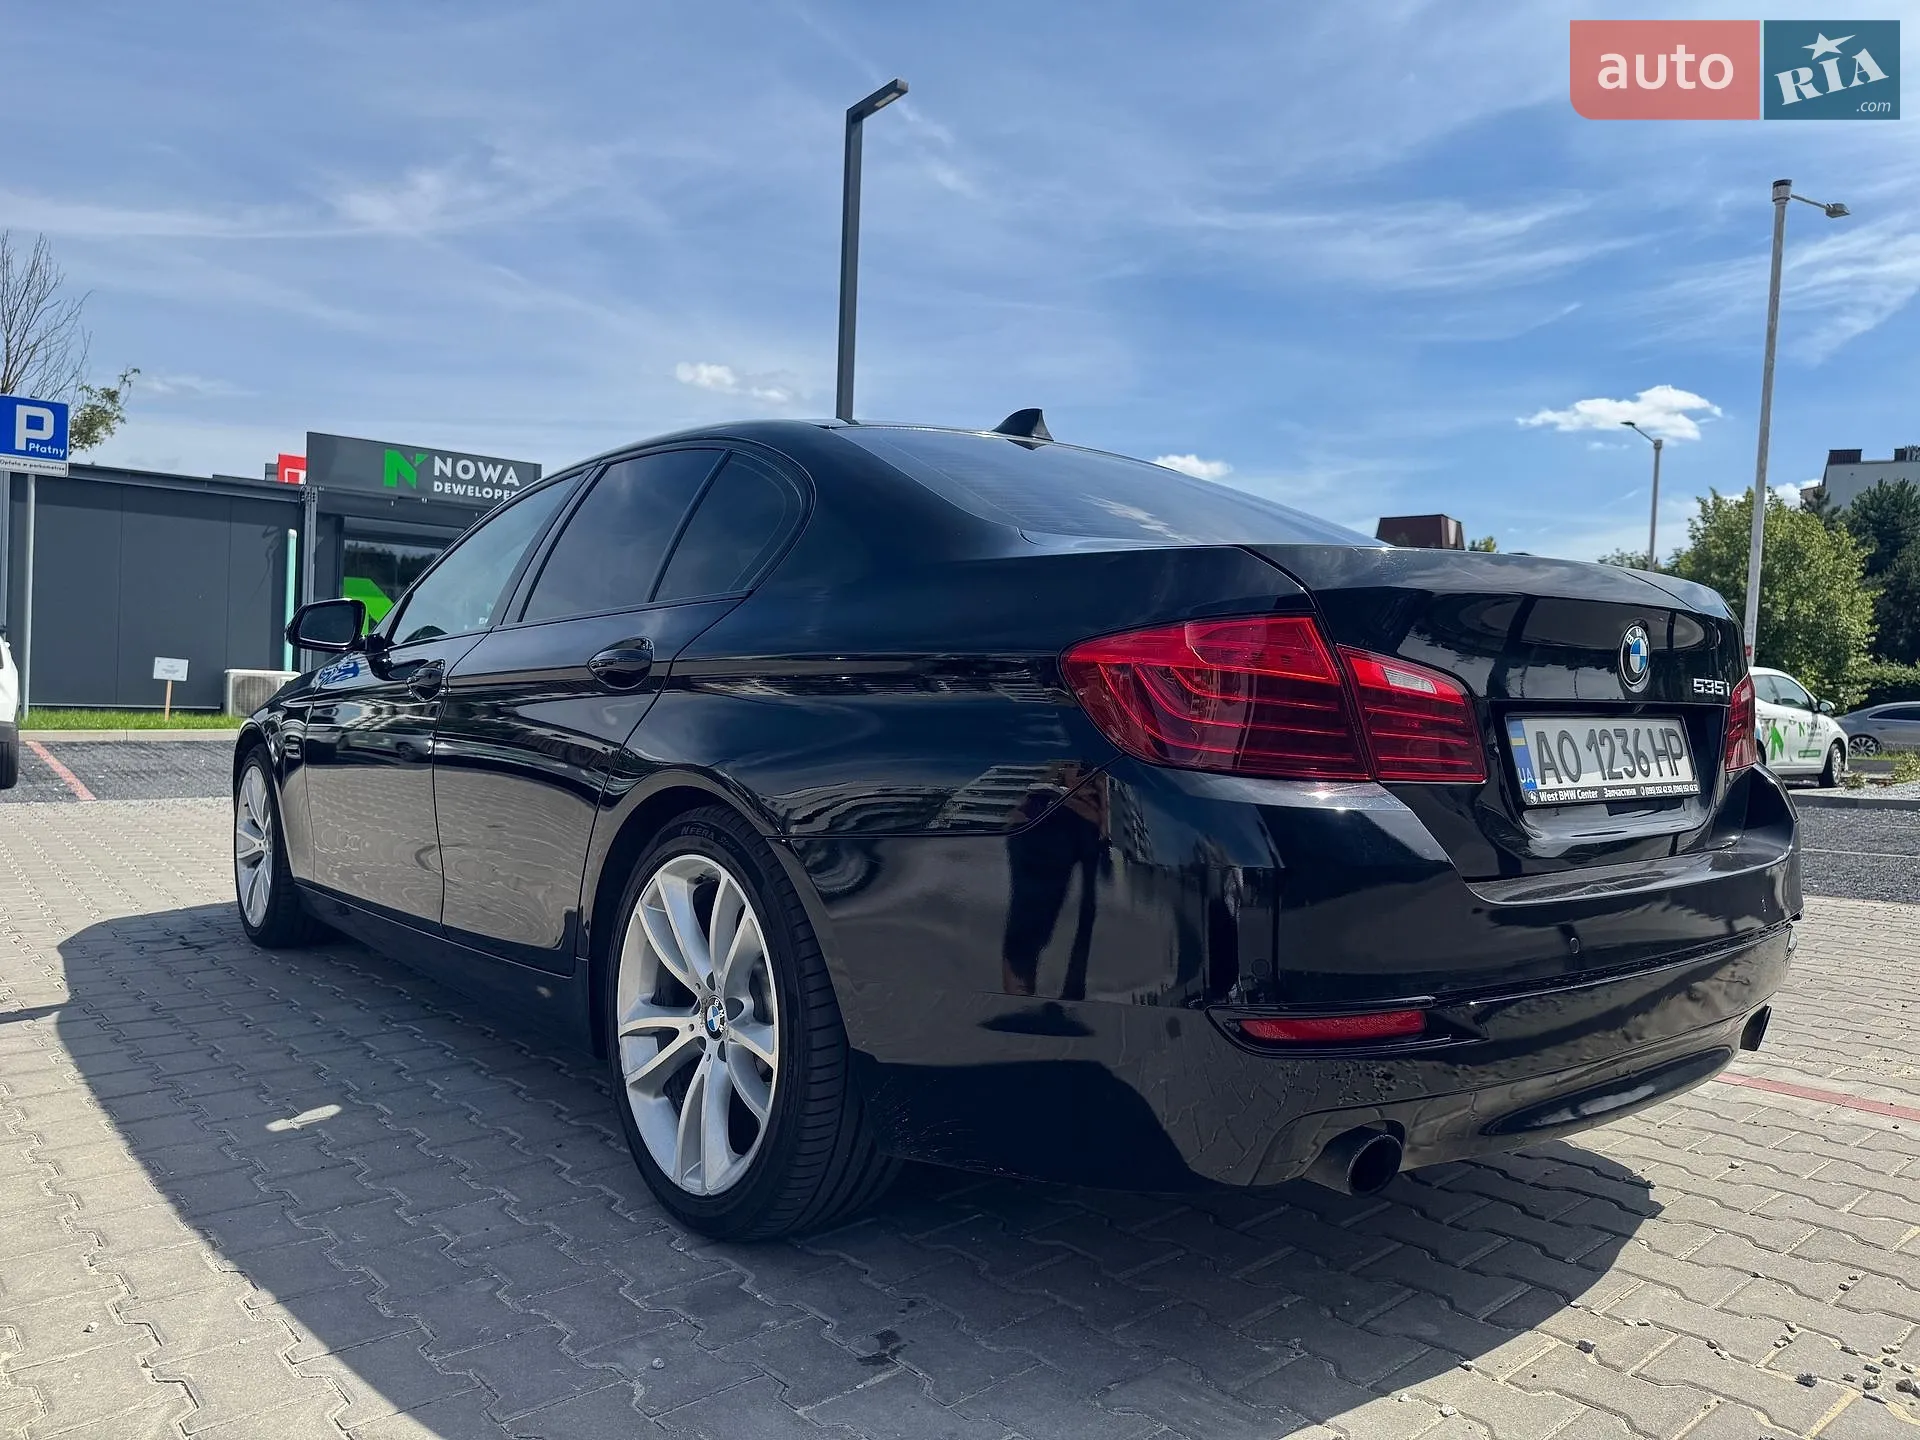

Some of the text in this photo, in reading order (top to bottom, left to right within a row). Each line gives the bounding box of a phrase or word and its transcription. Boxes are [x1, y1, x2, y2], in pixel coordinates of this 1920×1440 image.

[15, 404, 54, 450] P
[28, 442, 65, 457] Płatny
[434, 455, 520, 487] NOWA
[1693, 678, 1730, 697] 535i
[1535, 728, 1684, 785] AO 1236 HP
[1518, 767, 1535, 784] UA
[1539, 787, 1599, 802] West BMW Center
